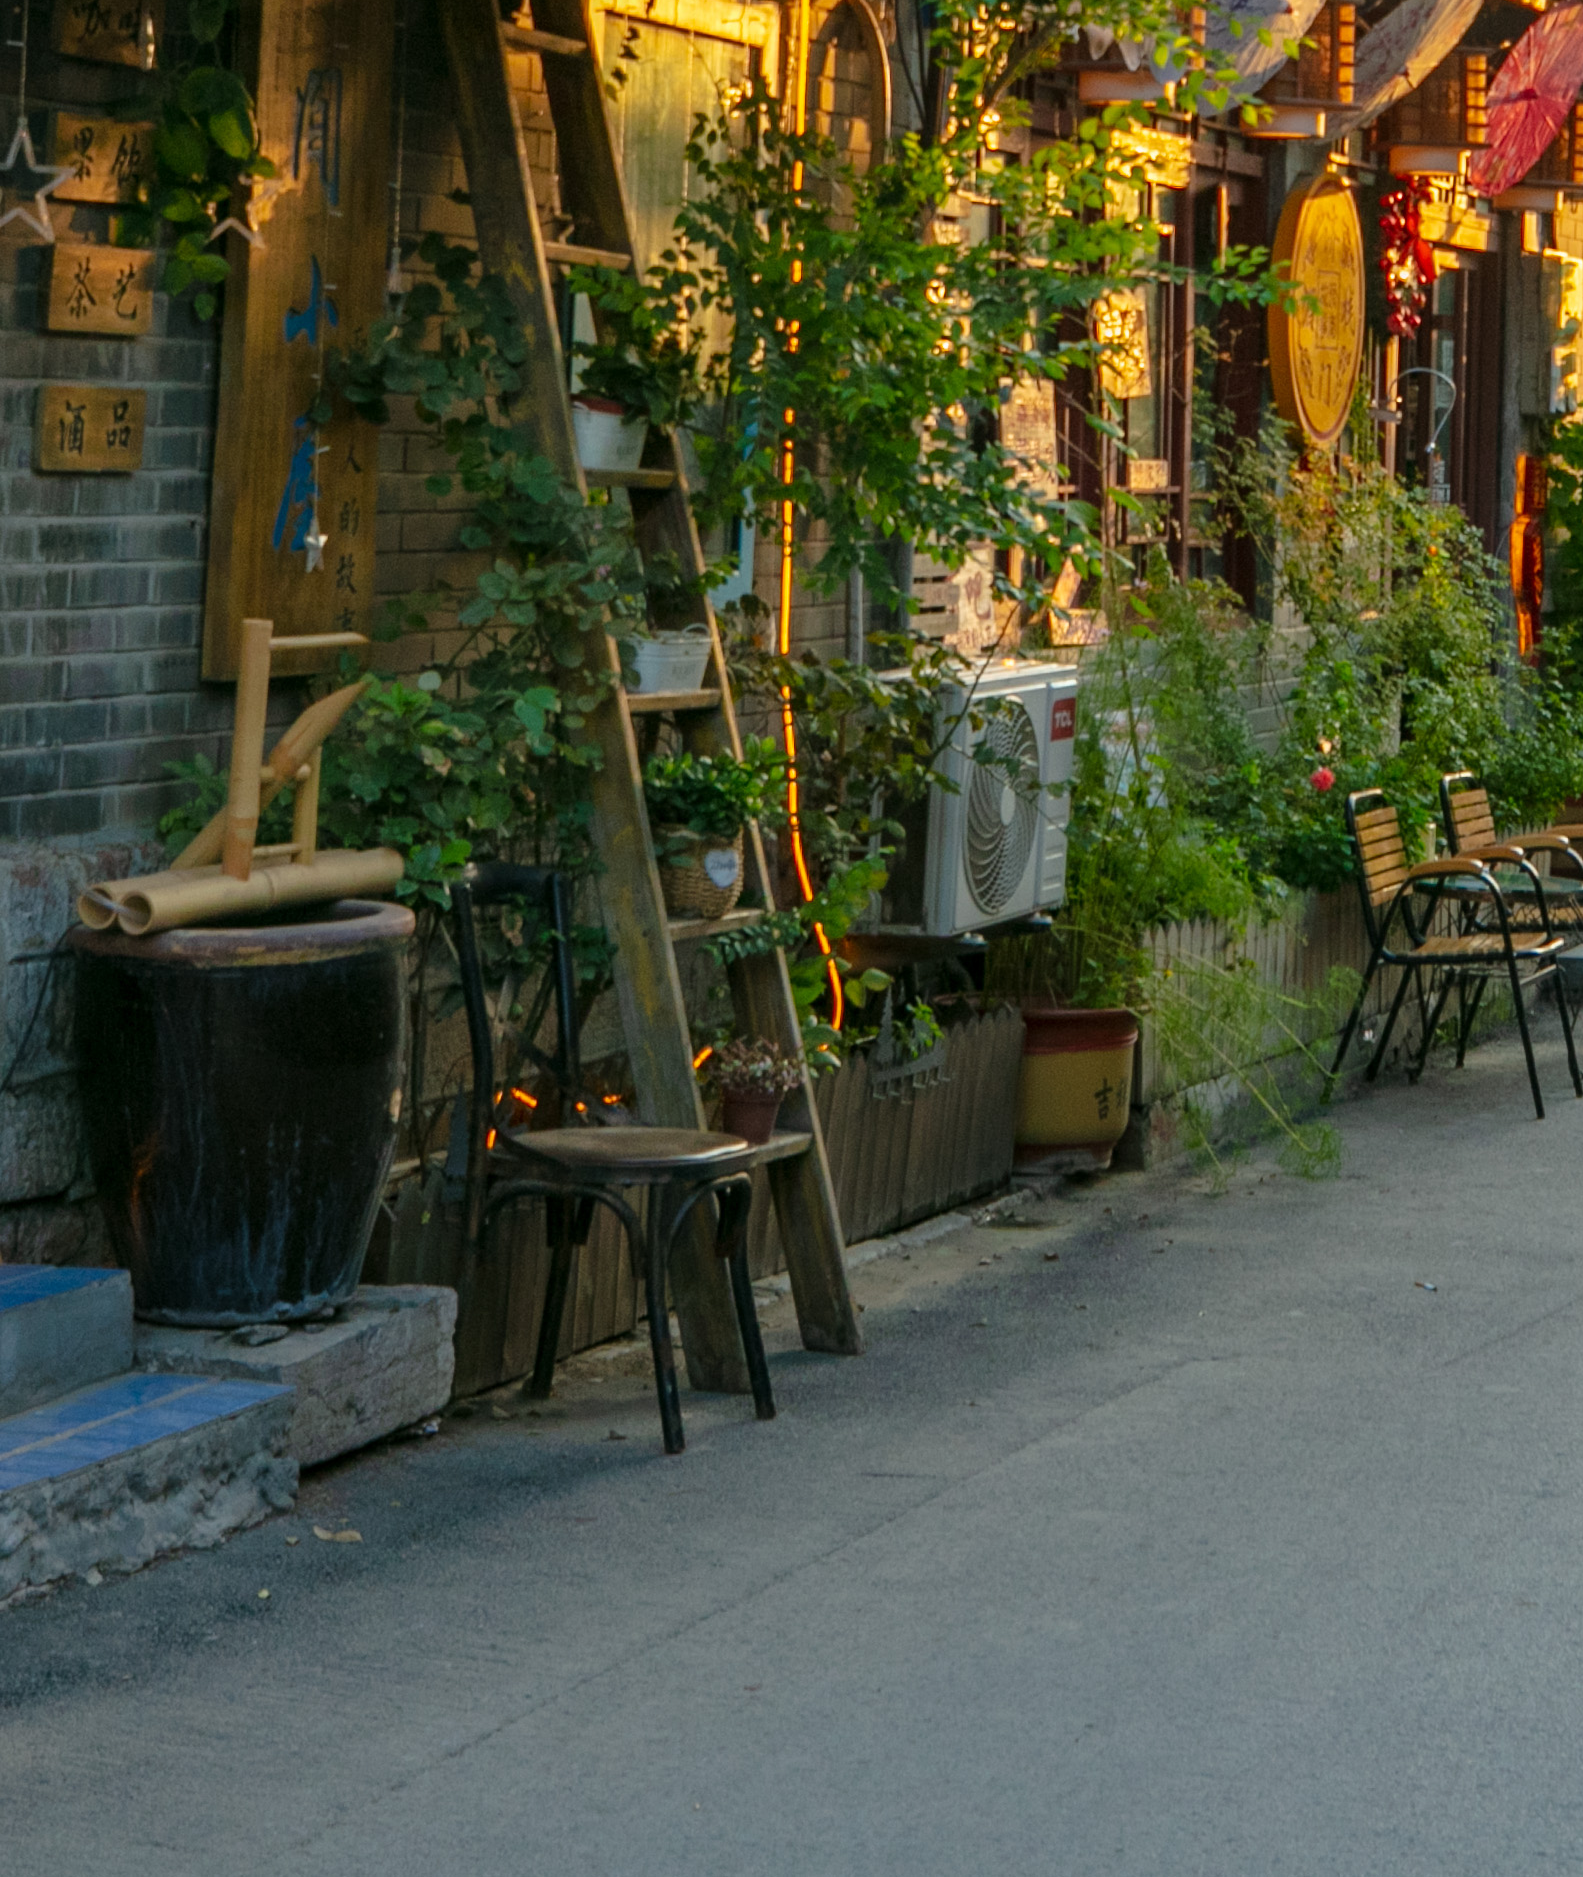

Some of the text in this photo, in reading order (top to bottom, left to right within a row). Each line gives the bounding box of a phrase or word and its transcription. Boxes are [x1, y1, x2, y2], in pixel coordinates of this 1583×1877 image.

[65, 255, 138, 320] 茶艺
[59, 399, 131, 455] 酒品
[1055, 710, 1073, 728] TCL
